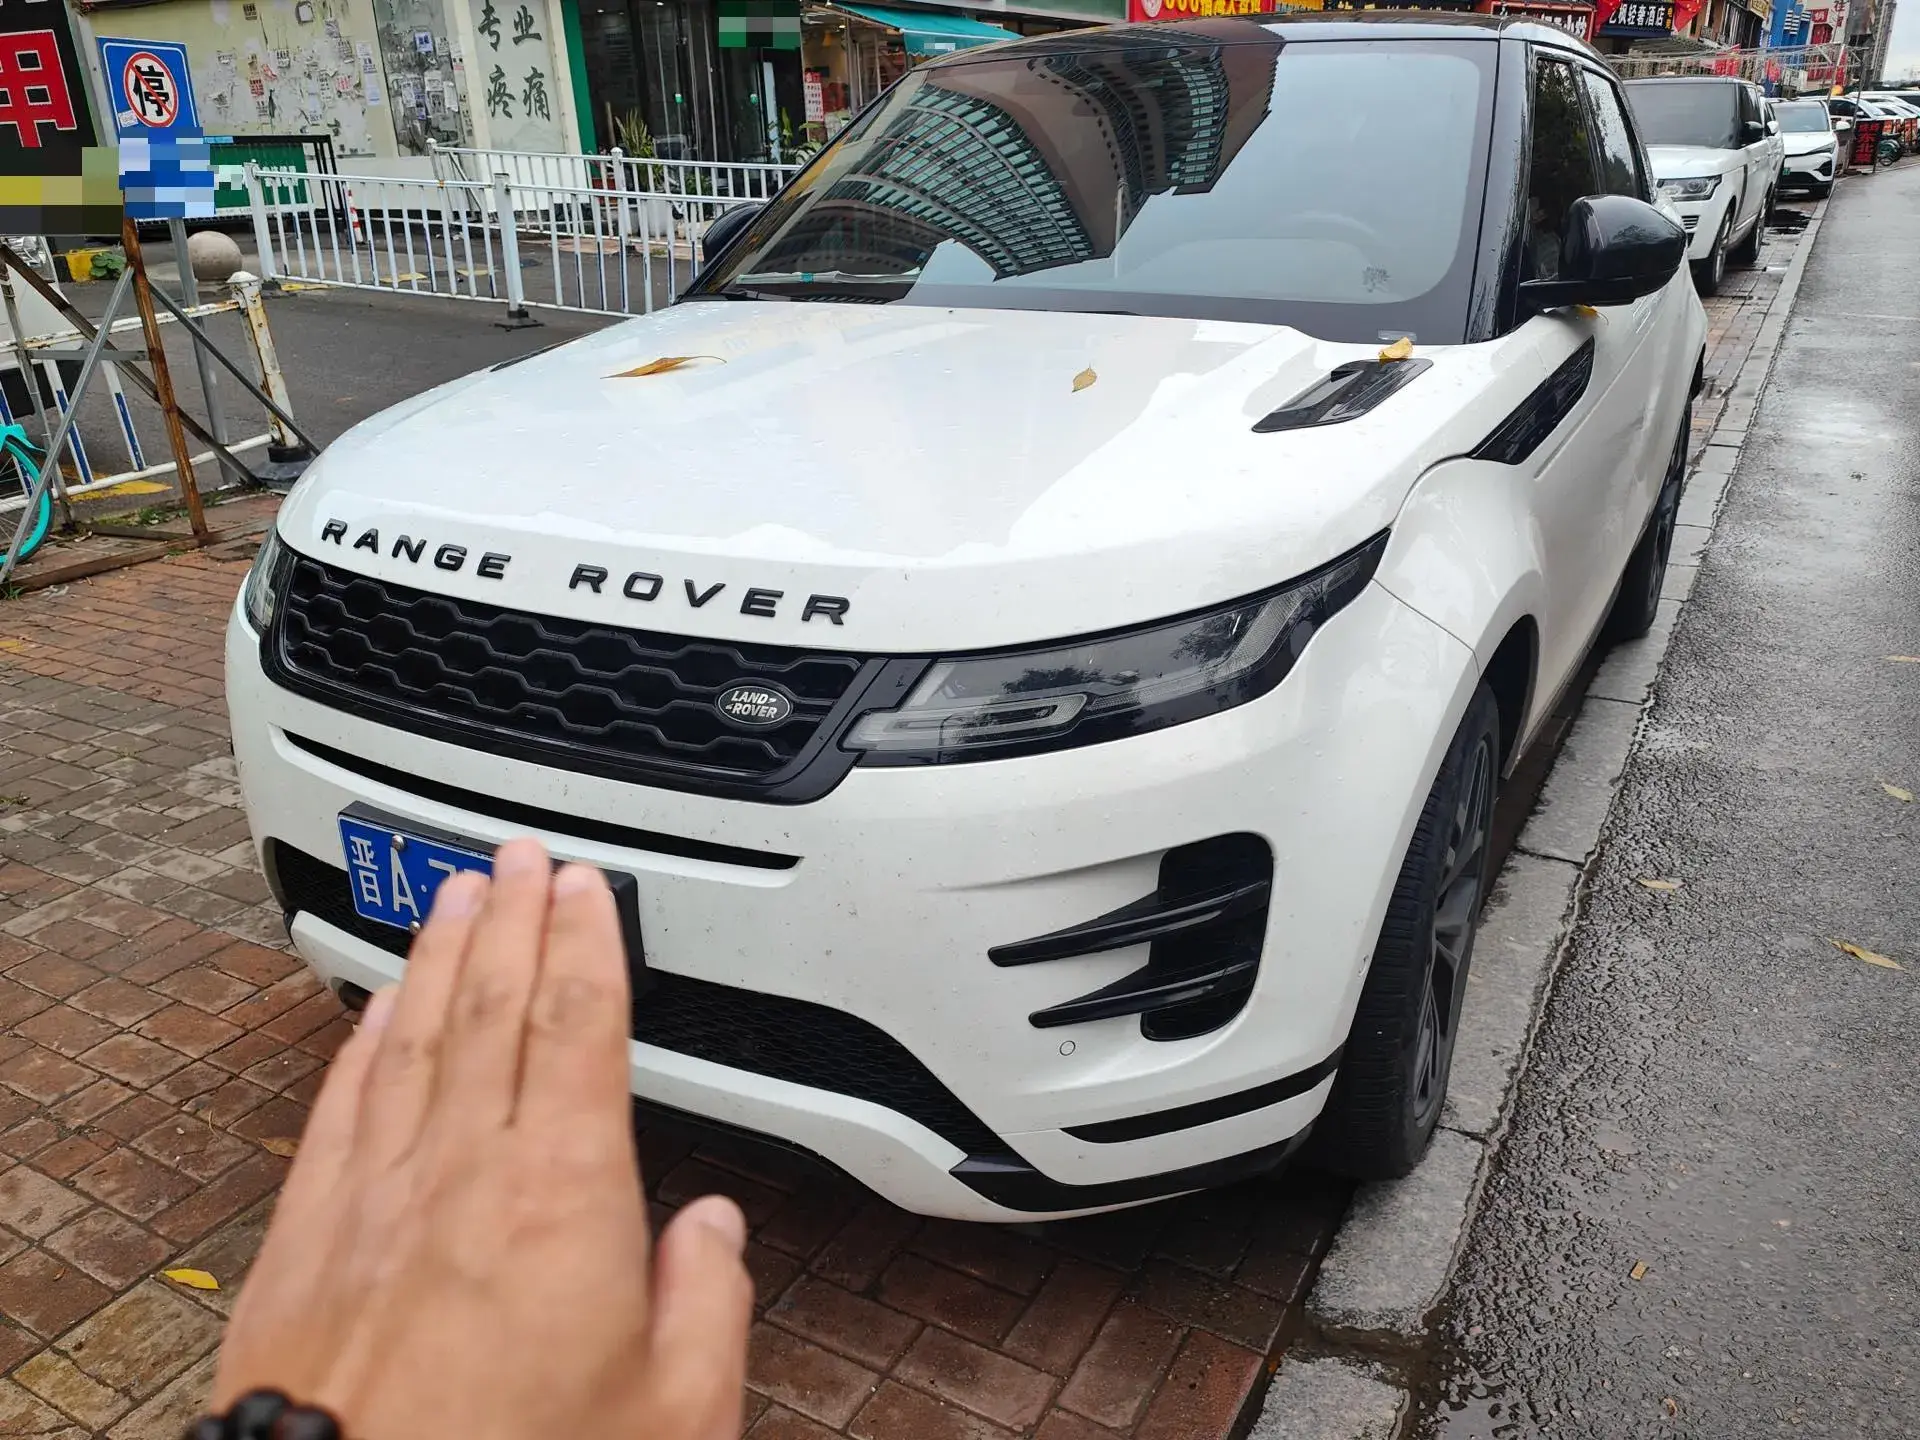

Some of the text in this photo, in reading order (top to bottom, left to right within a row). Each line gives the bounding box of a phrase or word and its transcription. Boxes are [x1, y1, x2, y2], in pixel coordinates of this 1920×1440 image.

[478, 0, 543, 53] 专业
[133, 64, 170, 116] 停
[487, 63, 551, 122] 疼痛
[321, 518, 850, 626] RANGE ROVER
[731, 690, 769, 705] LAND
[731, 702, 778, 718] ROVER
